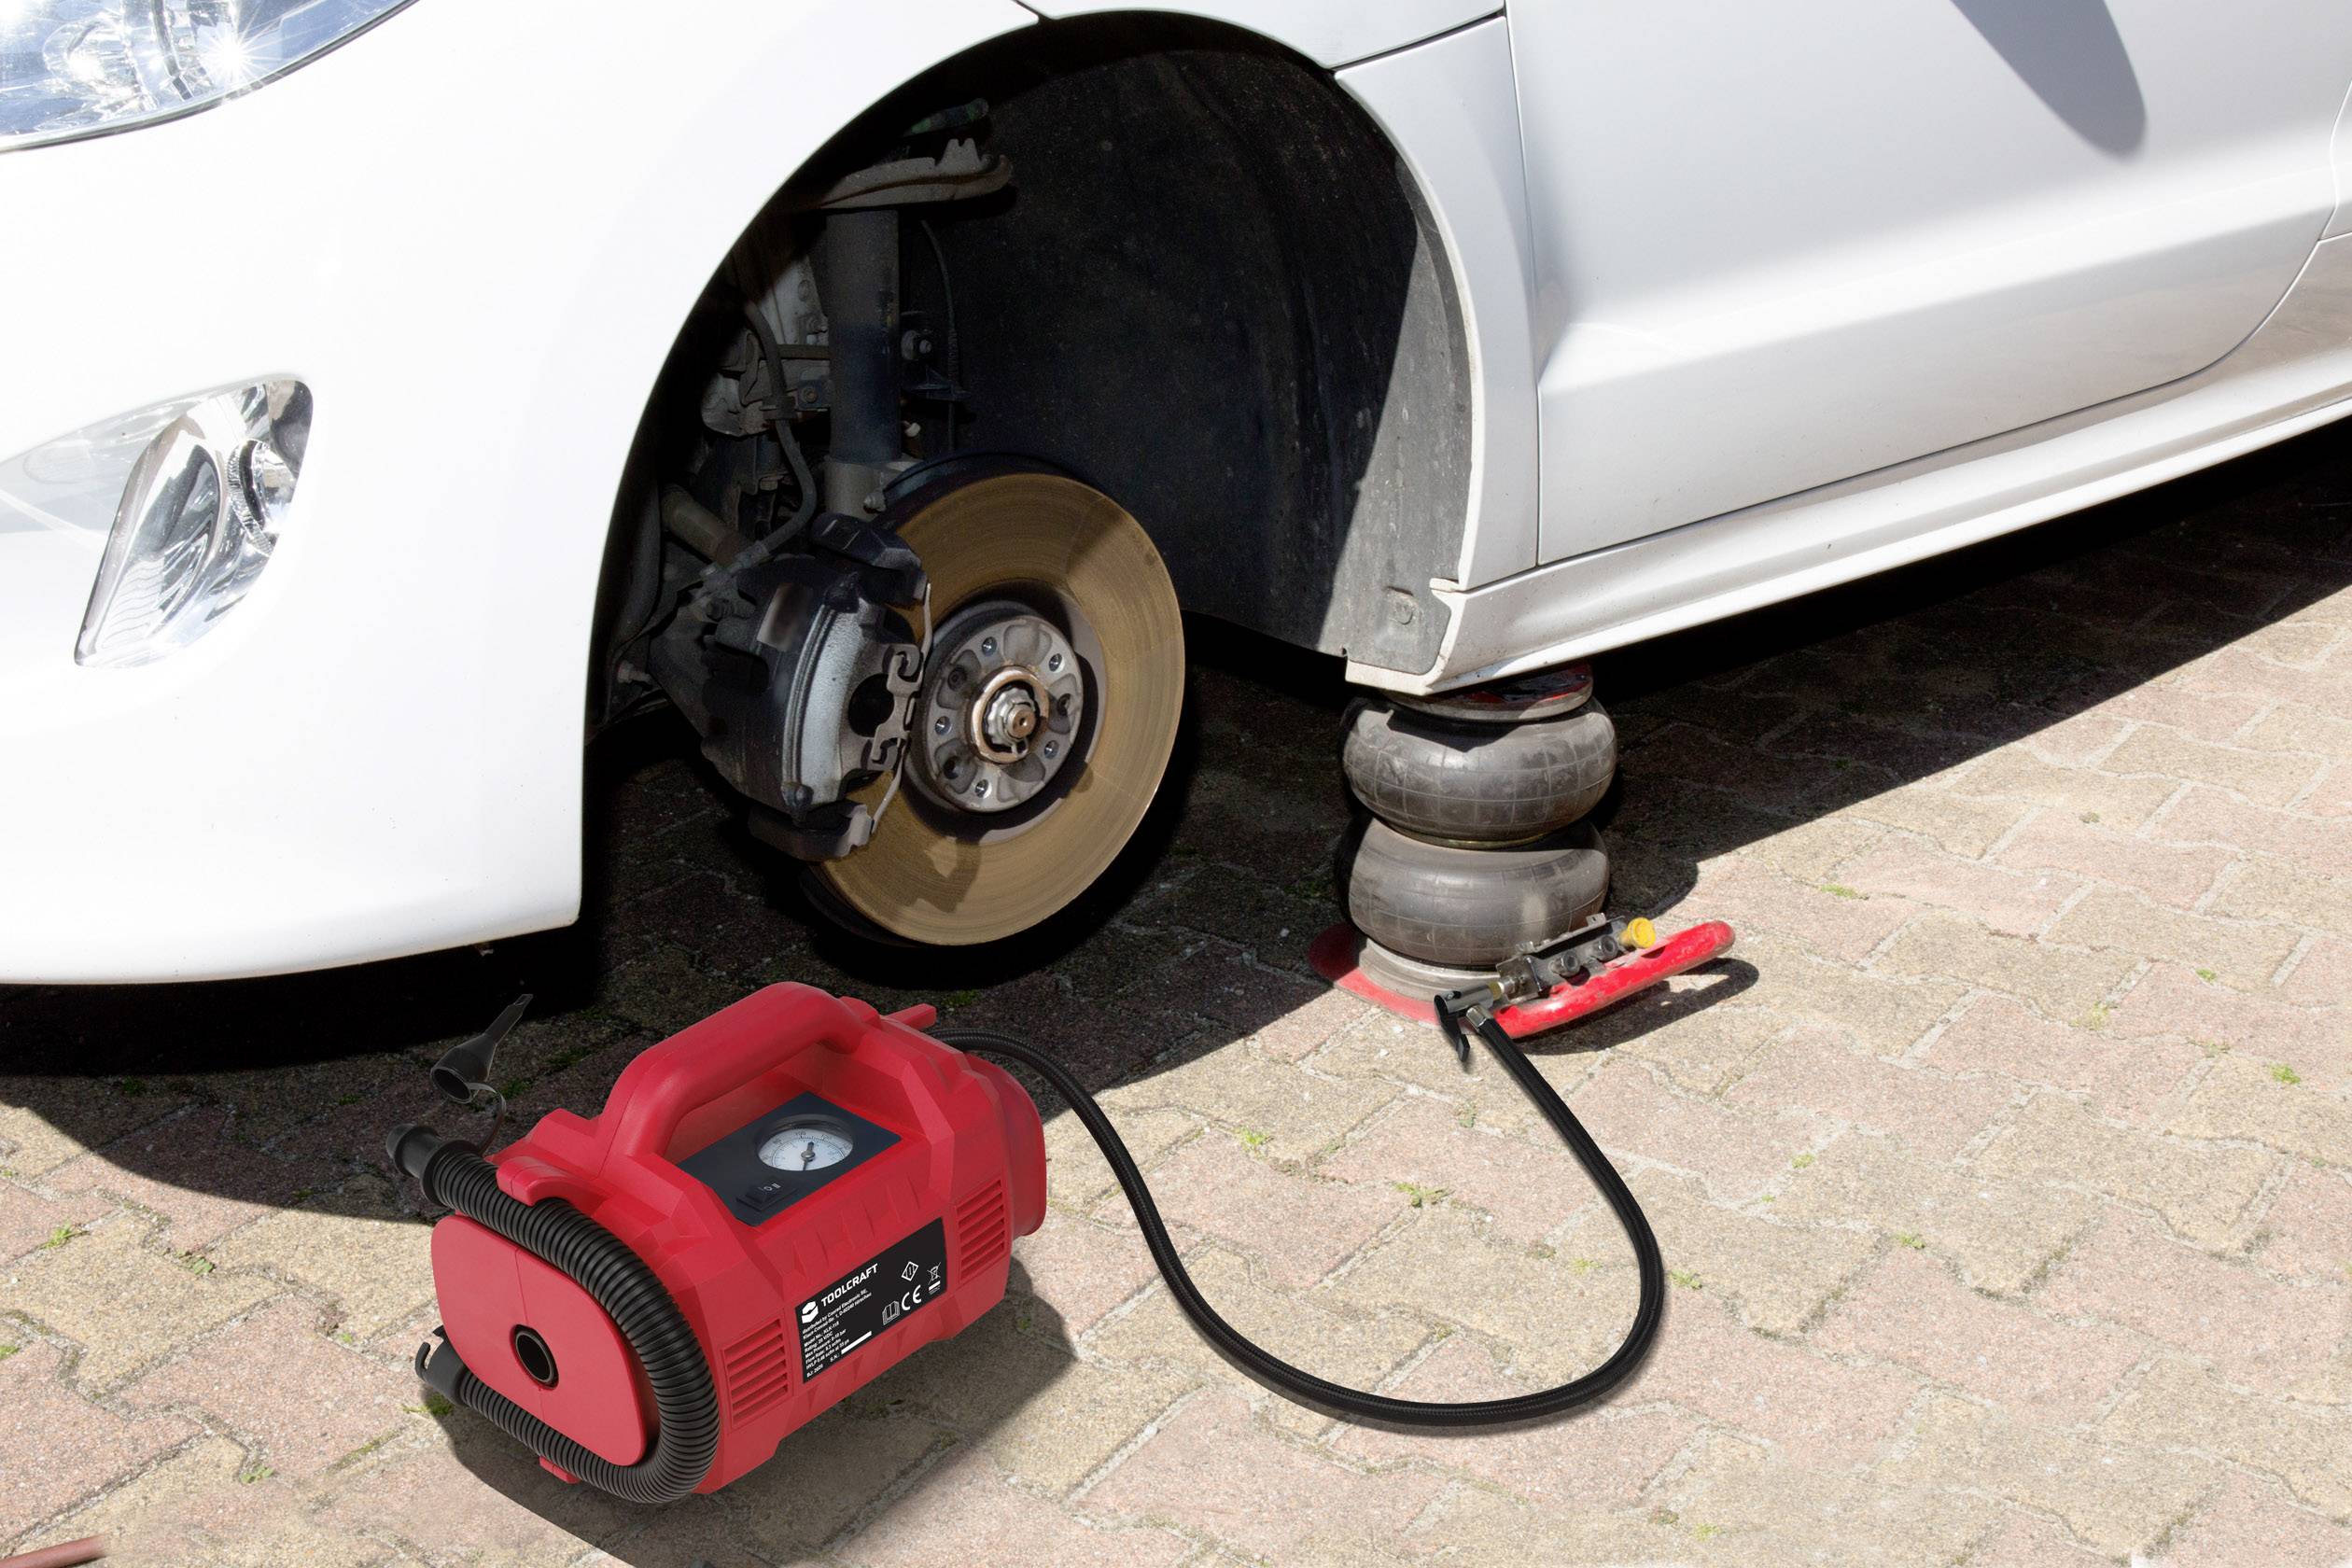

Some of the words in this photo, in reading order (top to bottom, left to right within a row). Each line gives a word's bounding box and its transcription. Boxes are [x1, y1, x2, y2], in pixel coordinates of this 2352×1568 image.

[820, 1263, 878, 1308] TOOLCRAFT
[901, 1285, 922, 1310] CE
[828, 1306, 841, 1318] Conrad
[804, 1337, 816, 1347] Model
[806, 1355, 815, 1365] Flow
